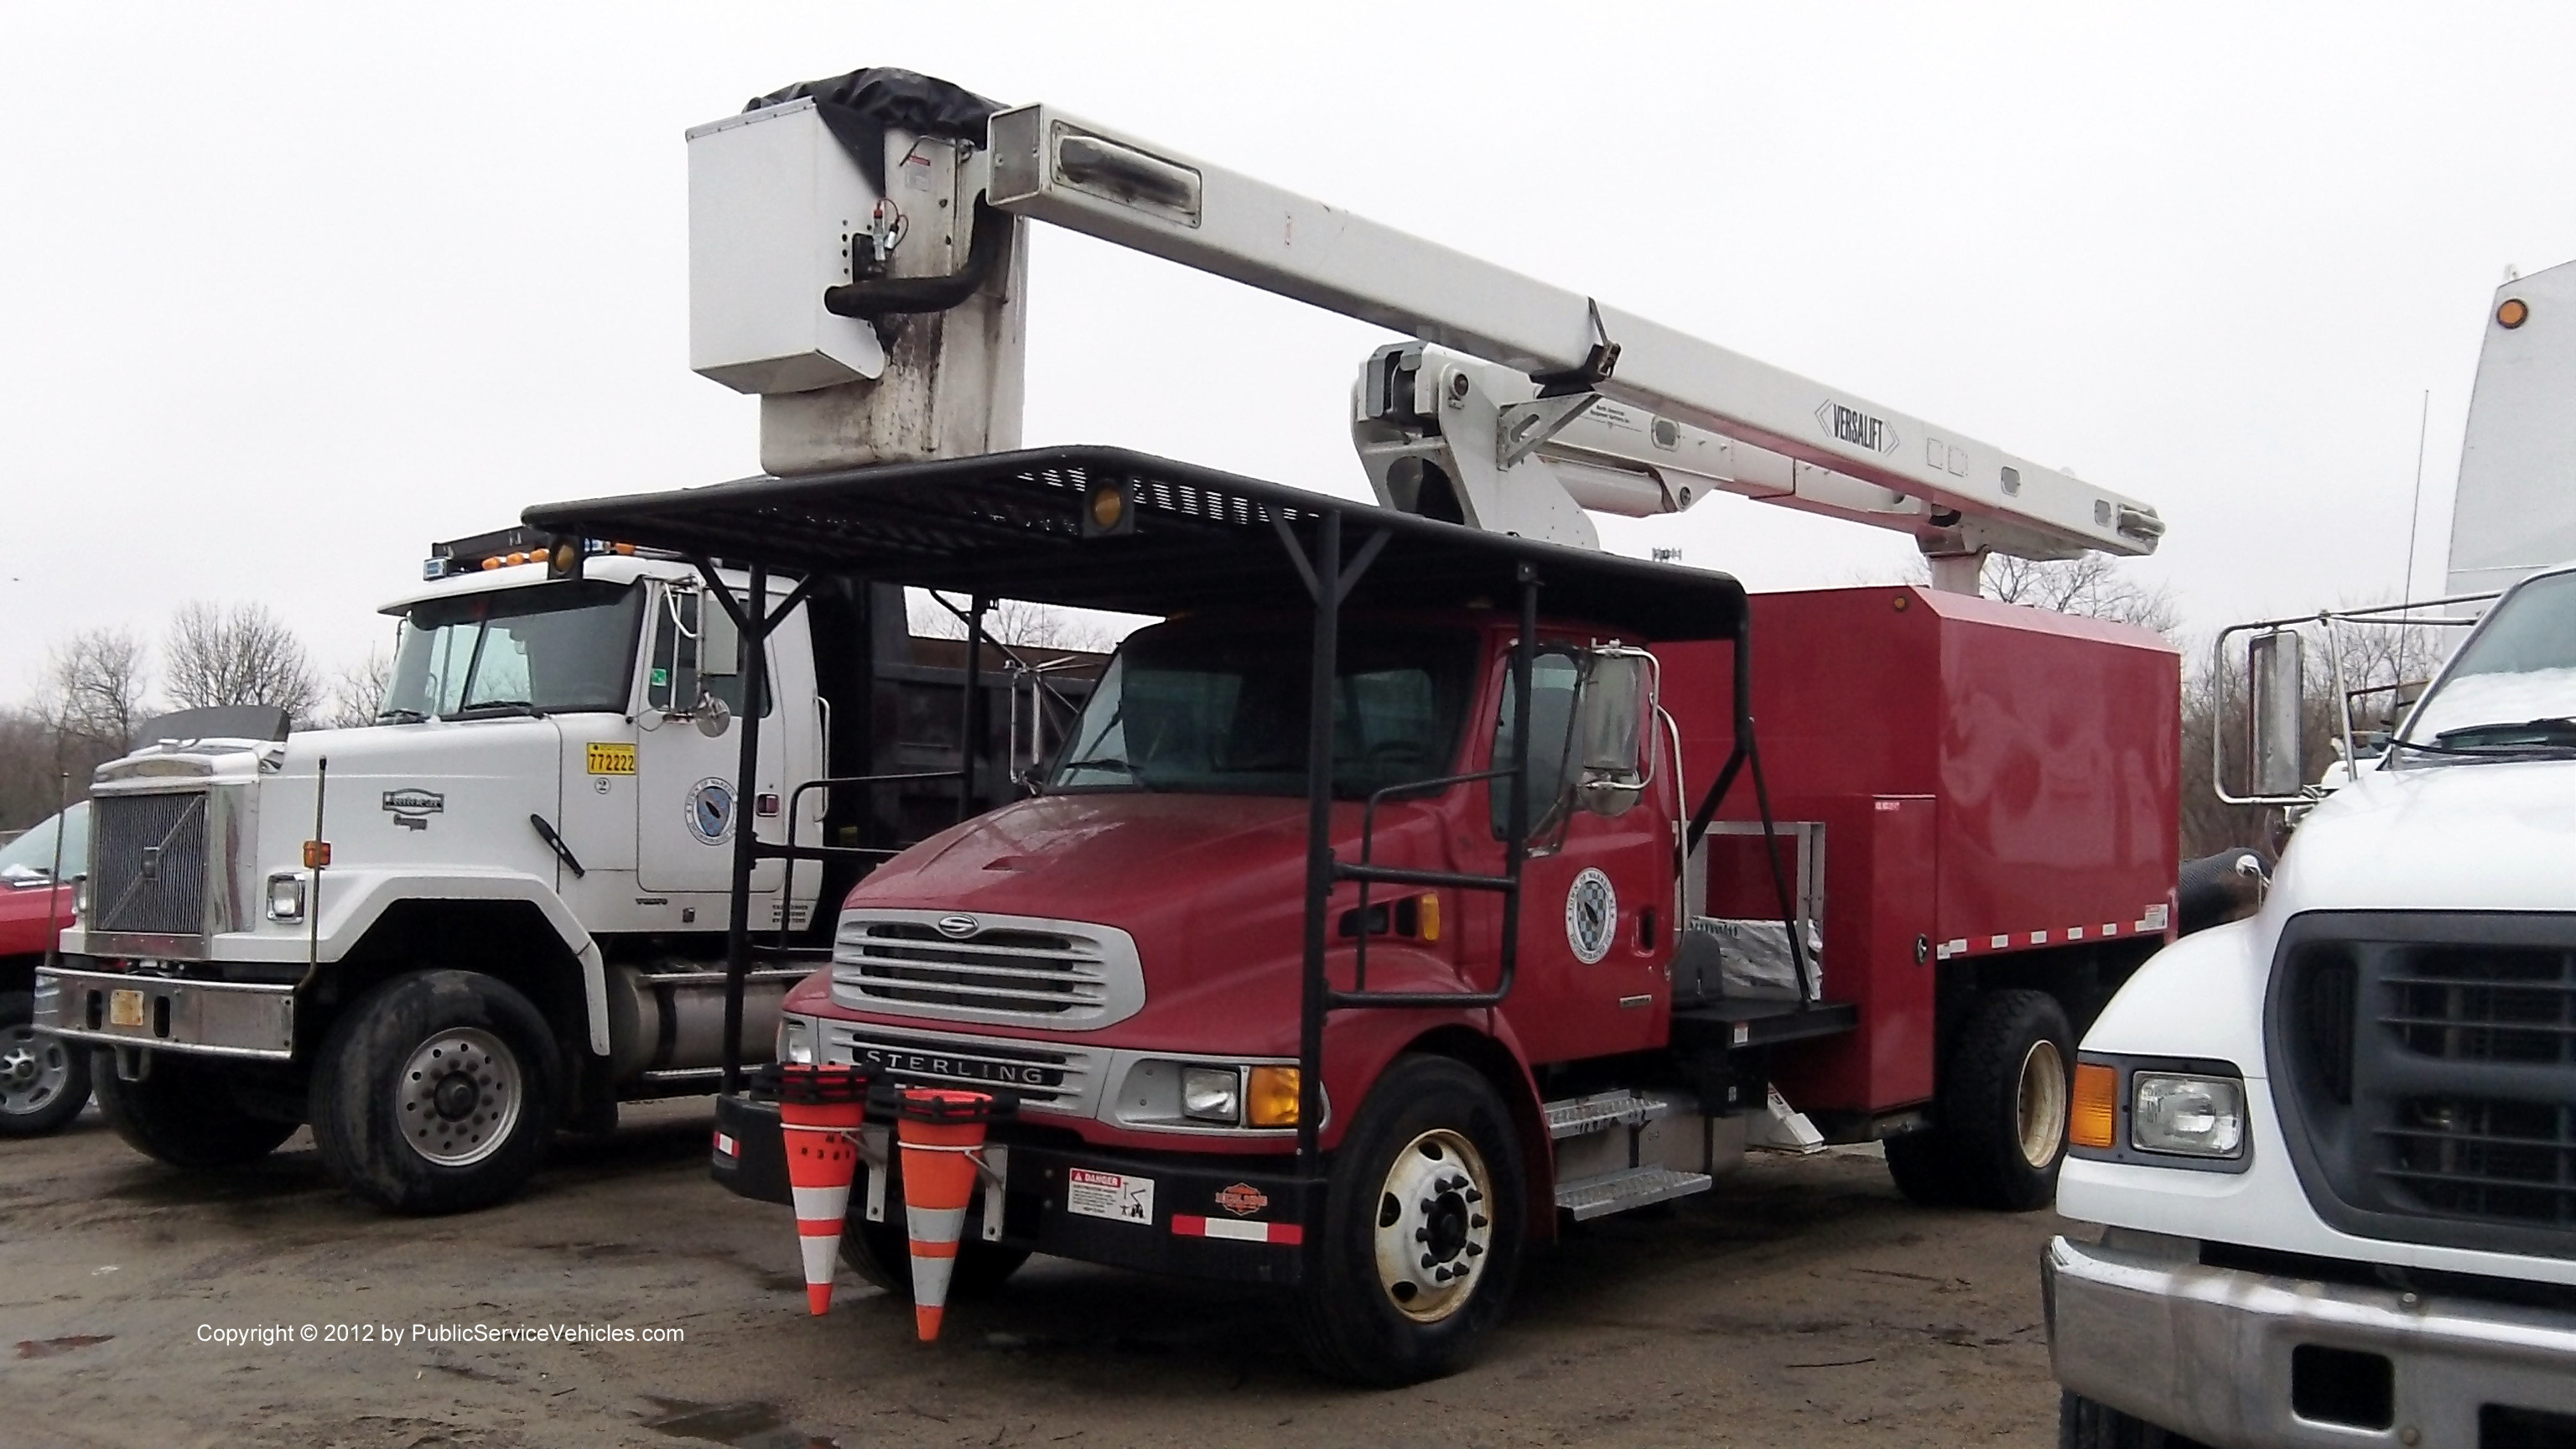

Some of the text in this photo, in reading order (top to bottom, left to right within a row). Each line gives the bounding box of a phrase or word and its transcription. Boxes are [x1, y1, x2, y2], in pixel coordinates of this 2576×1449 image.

[1833, 403, 1883, 452] VERSALIFT
[589, 753, 634, 771] 772222
[866, 1050, 1043, 1084] STERLING
[1084, 1173, 1119, 1187] DANGER
